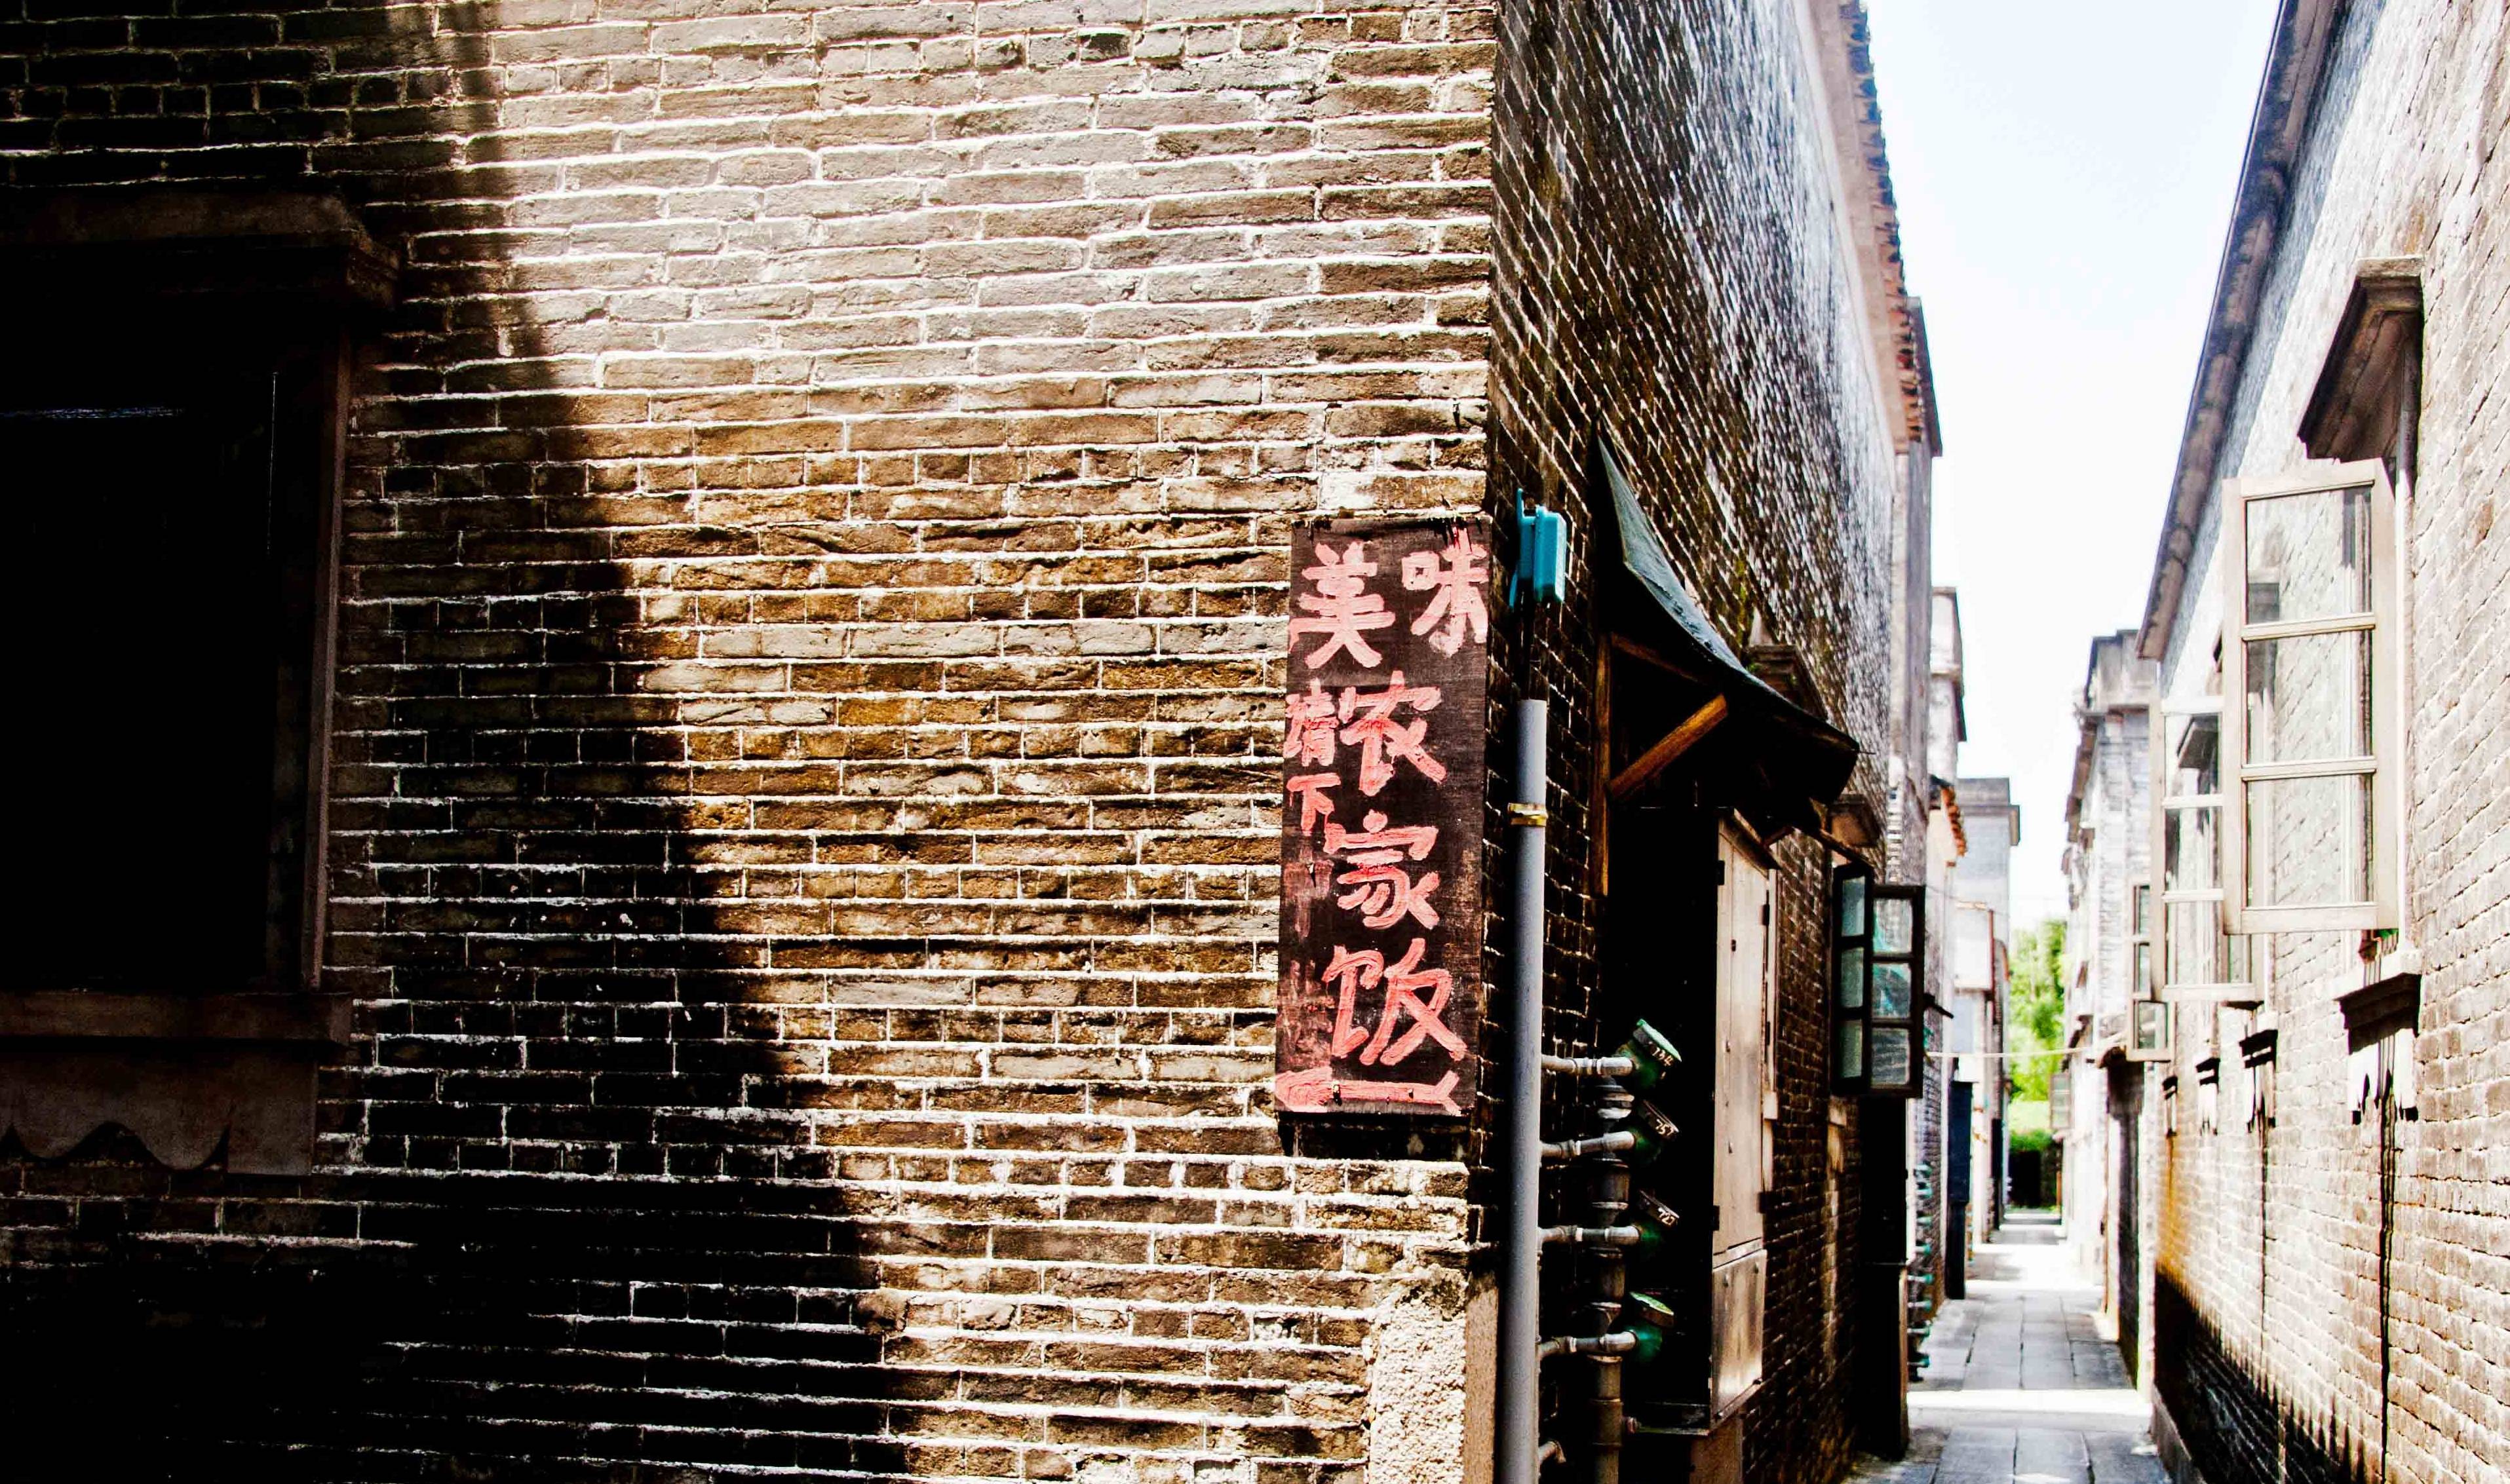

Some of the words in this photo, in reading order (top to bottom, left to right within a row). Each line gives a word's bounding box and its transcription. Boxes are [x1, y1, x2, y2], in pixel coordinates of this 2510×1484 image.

[1289, 527, 1488, 668] 美味
[1323, 670, 1469, 1066] 农家饭
